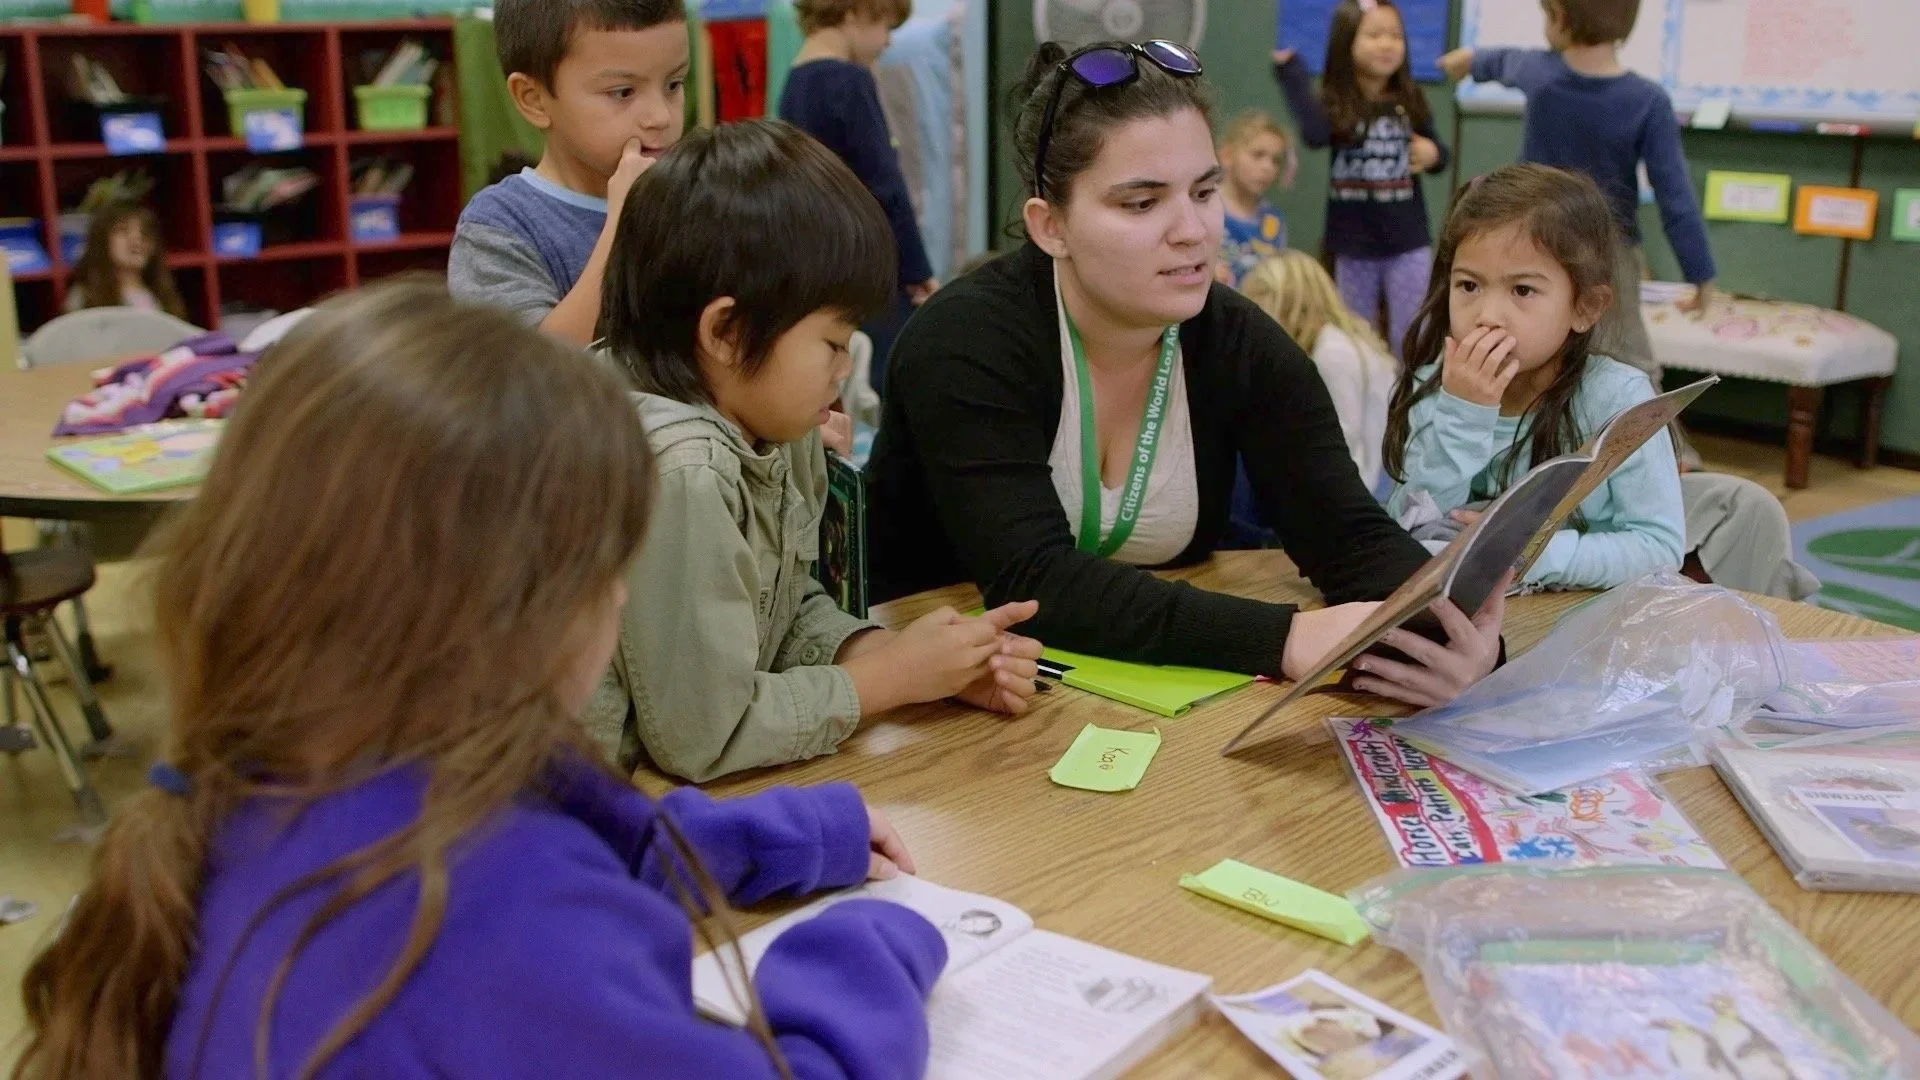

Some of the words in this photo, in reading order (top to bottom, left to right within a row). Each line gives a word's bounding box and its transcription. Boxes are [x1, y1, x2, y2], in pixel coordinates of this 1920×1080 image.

[1164, 349, 1174, 375] Los
[1147, 376, 1167, 419] World
[1141, 422, 1156, 446] the
[1138, 446, 1150, 463] of
[1121, 466, 1146, 521] Citizens
